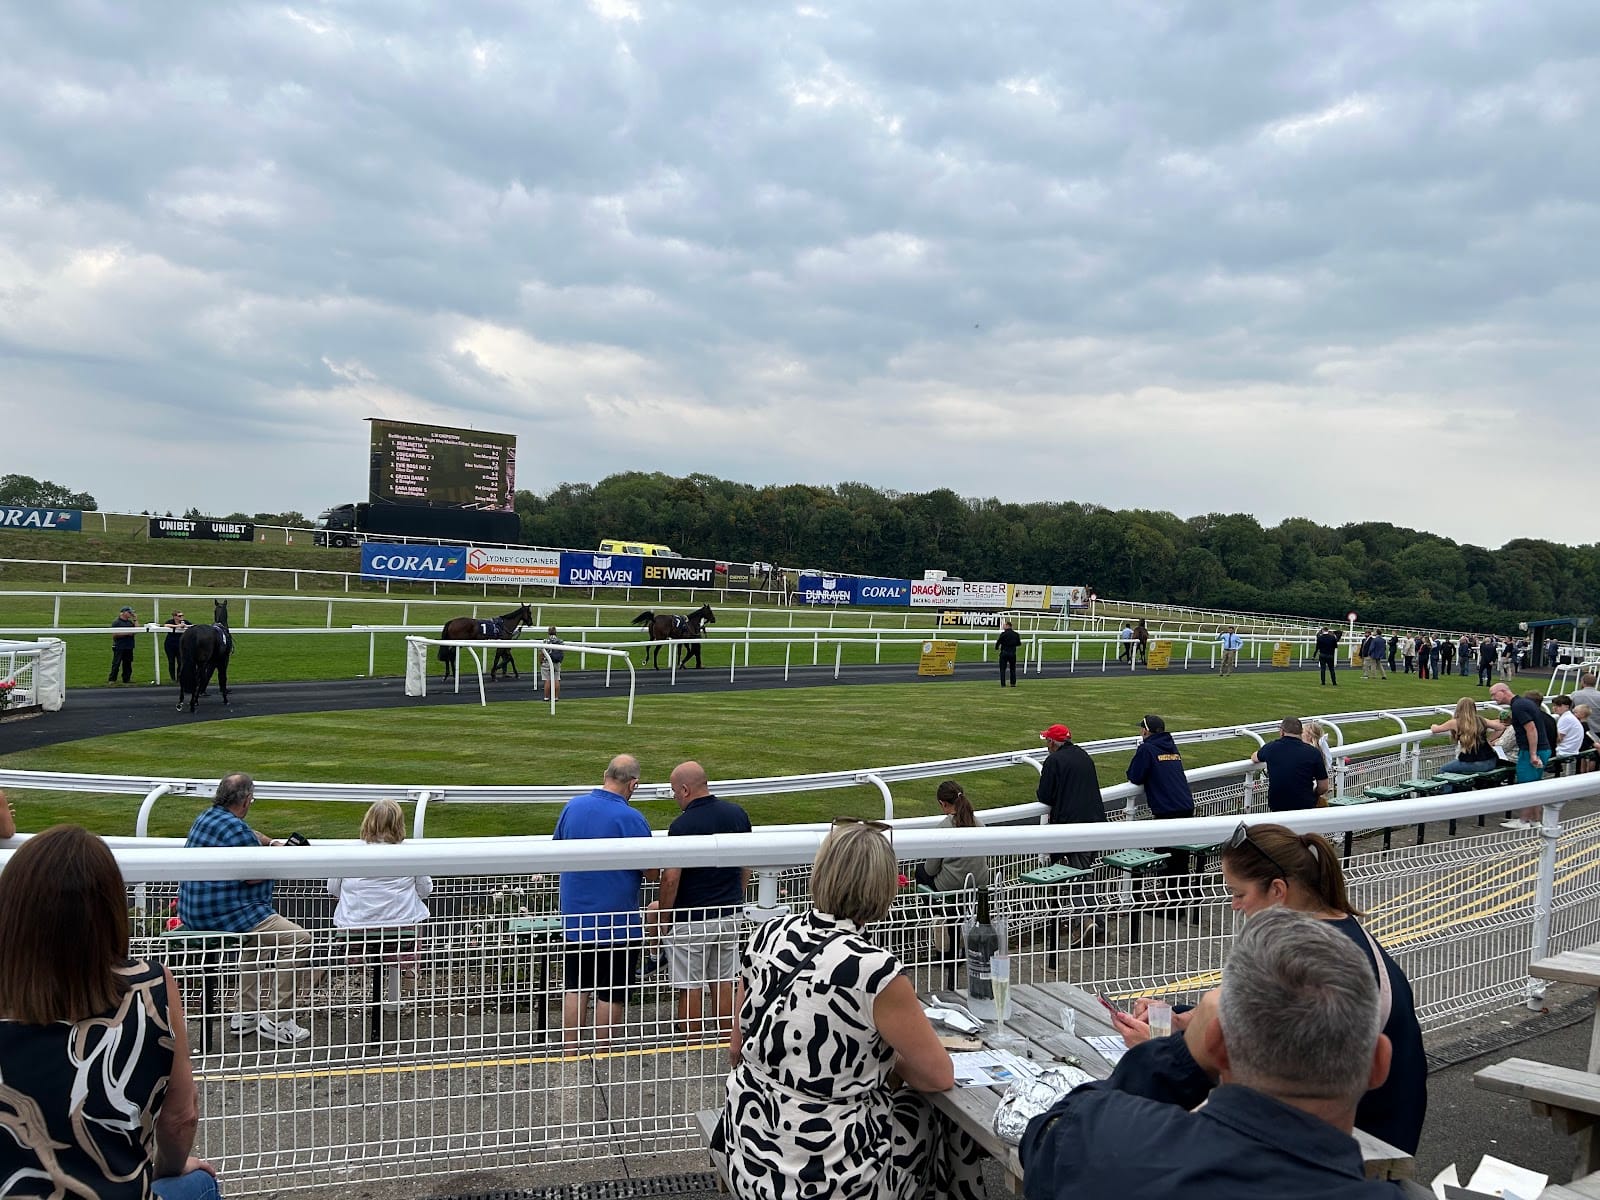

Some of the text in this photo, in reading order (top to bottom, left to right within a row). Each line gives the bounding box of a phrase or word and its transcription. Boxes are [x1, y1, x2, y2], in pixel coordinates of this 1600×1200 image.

[160, 520, 197, 532] UNIBET
[211, 523, 247, 534] UNIBET
[371, 555, 447, 572] CORAL
[515, 557, 558, 565] CONTAINERS
[570, 568, 633, 582] DUNRAVEN
[645, 565, 713, 583] BETWRIGHT
[862, 586, 901, 598] CORAL
[911, 583, 960, 596] DRAGONBET
[963, 583, 1006, 593] REEDER
[806, 589, 851, 600] DUNRAVEN
[943, 610, 1000, 626] BETWRIGHT
[480, 623, 487, 634] 1
